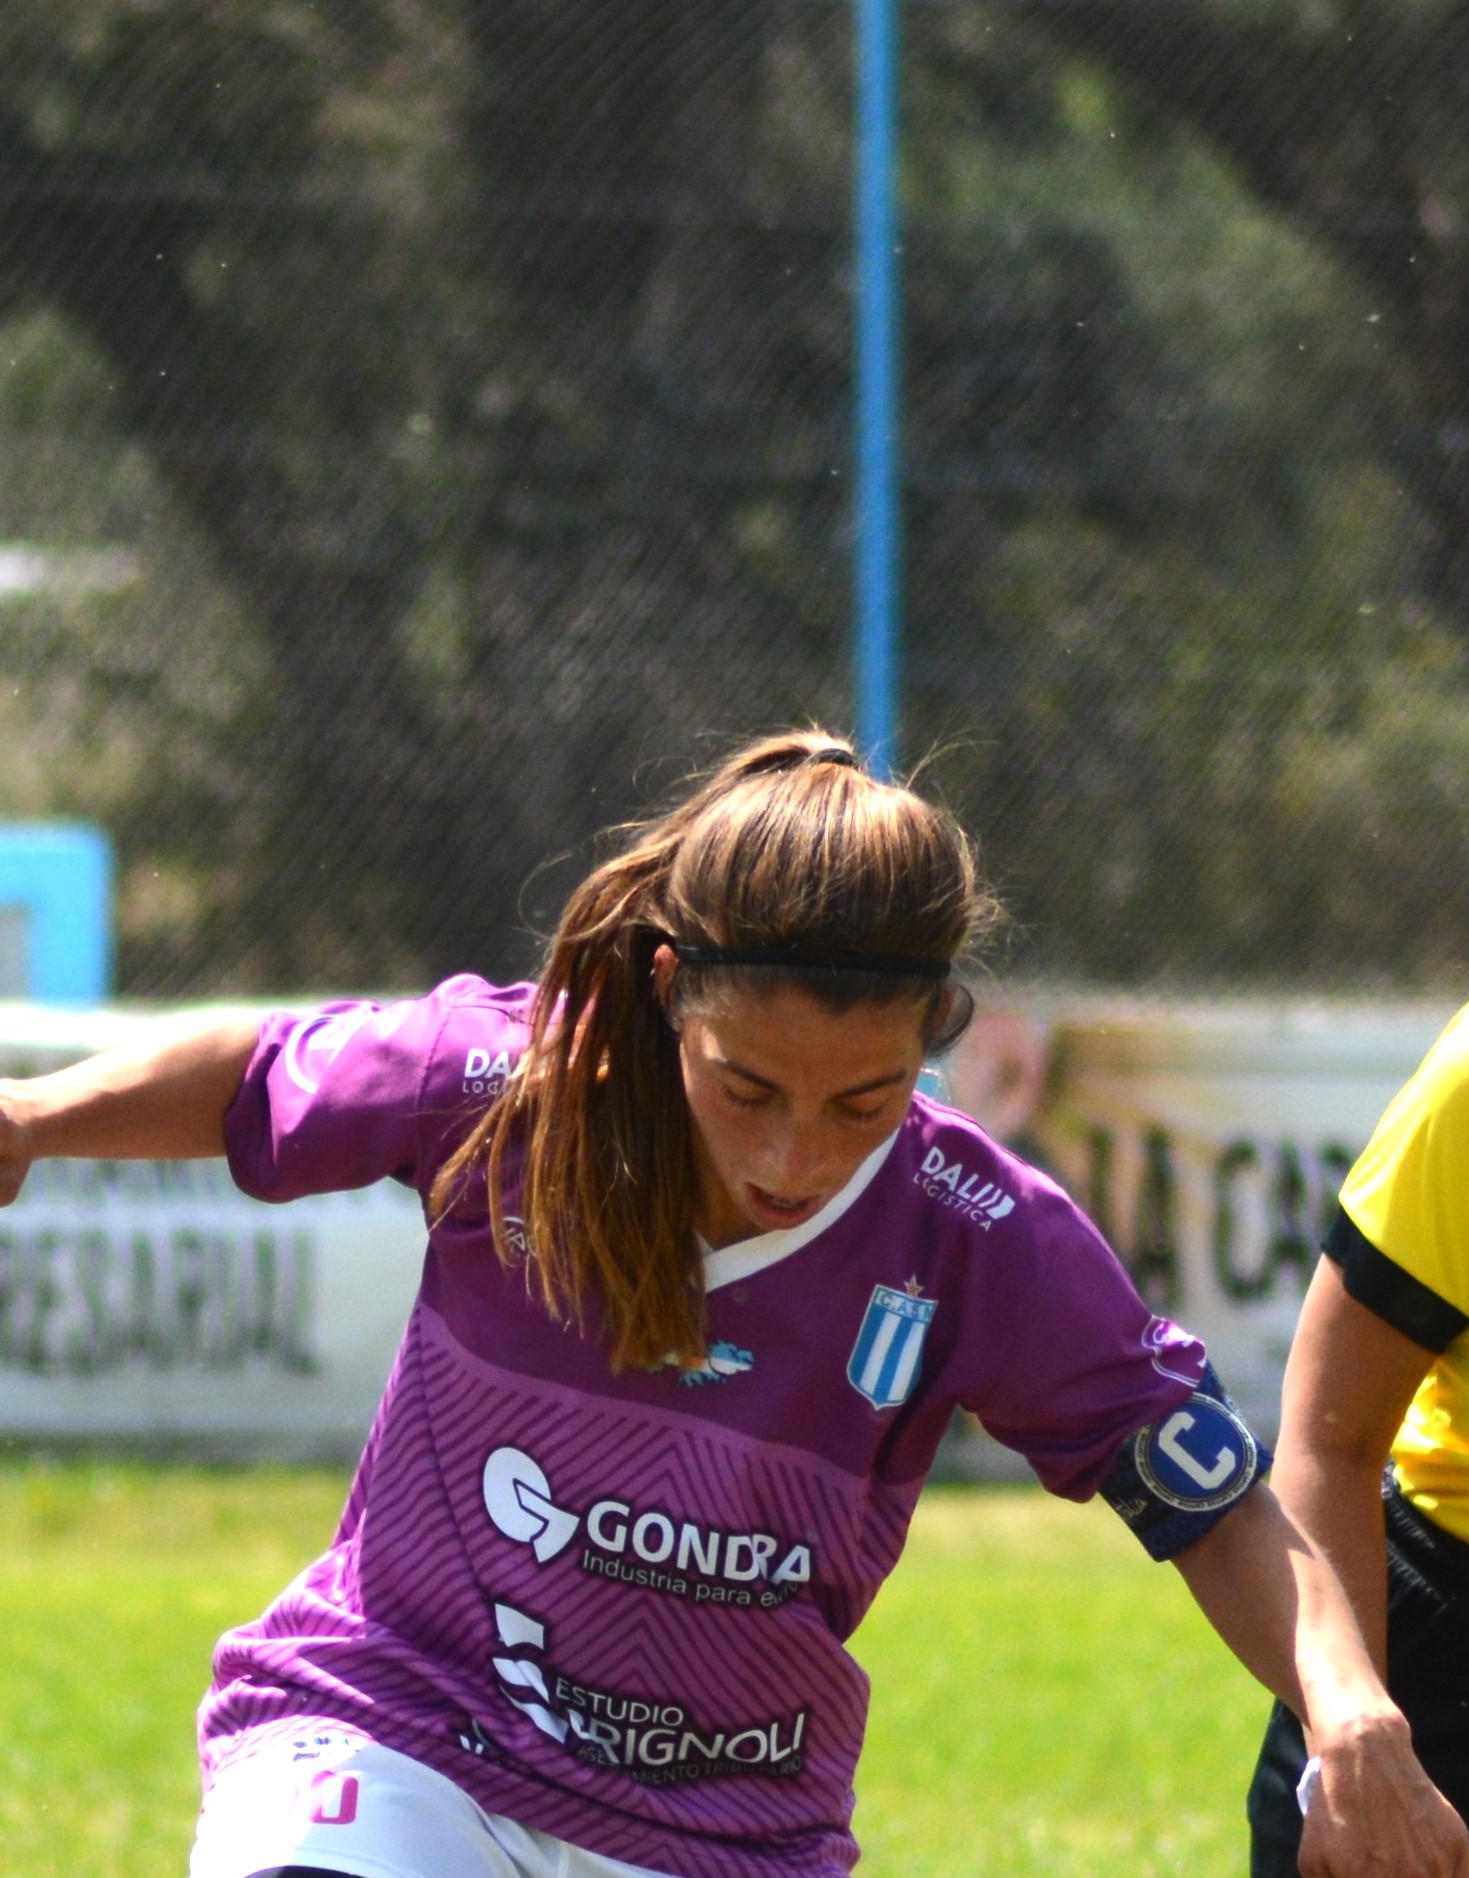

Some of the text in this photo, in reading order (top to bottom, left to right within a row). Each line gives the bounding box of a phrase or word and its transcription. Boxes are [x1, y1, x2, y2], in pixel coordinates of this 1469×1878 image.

[1158, 1410, 1236, 1490] C
[581, 1548, 688, 1596] Industria
[695, 1582, 752, 1606] para
[555, 1676, 685, 1727] ESTUDIO
